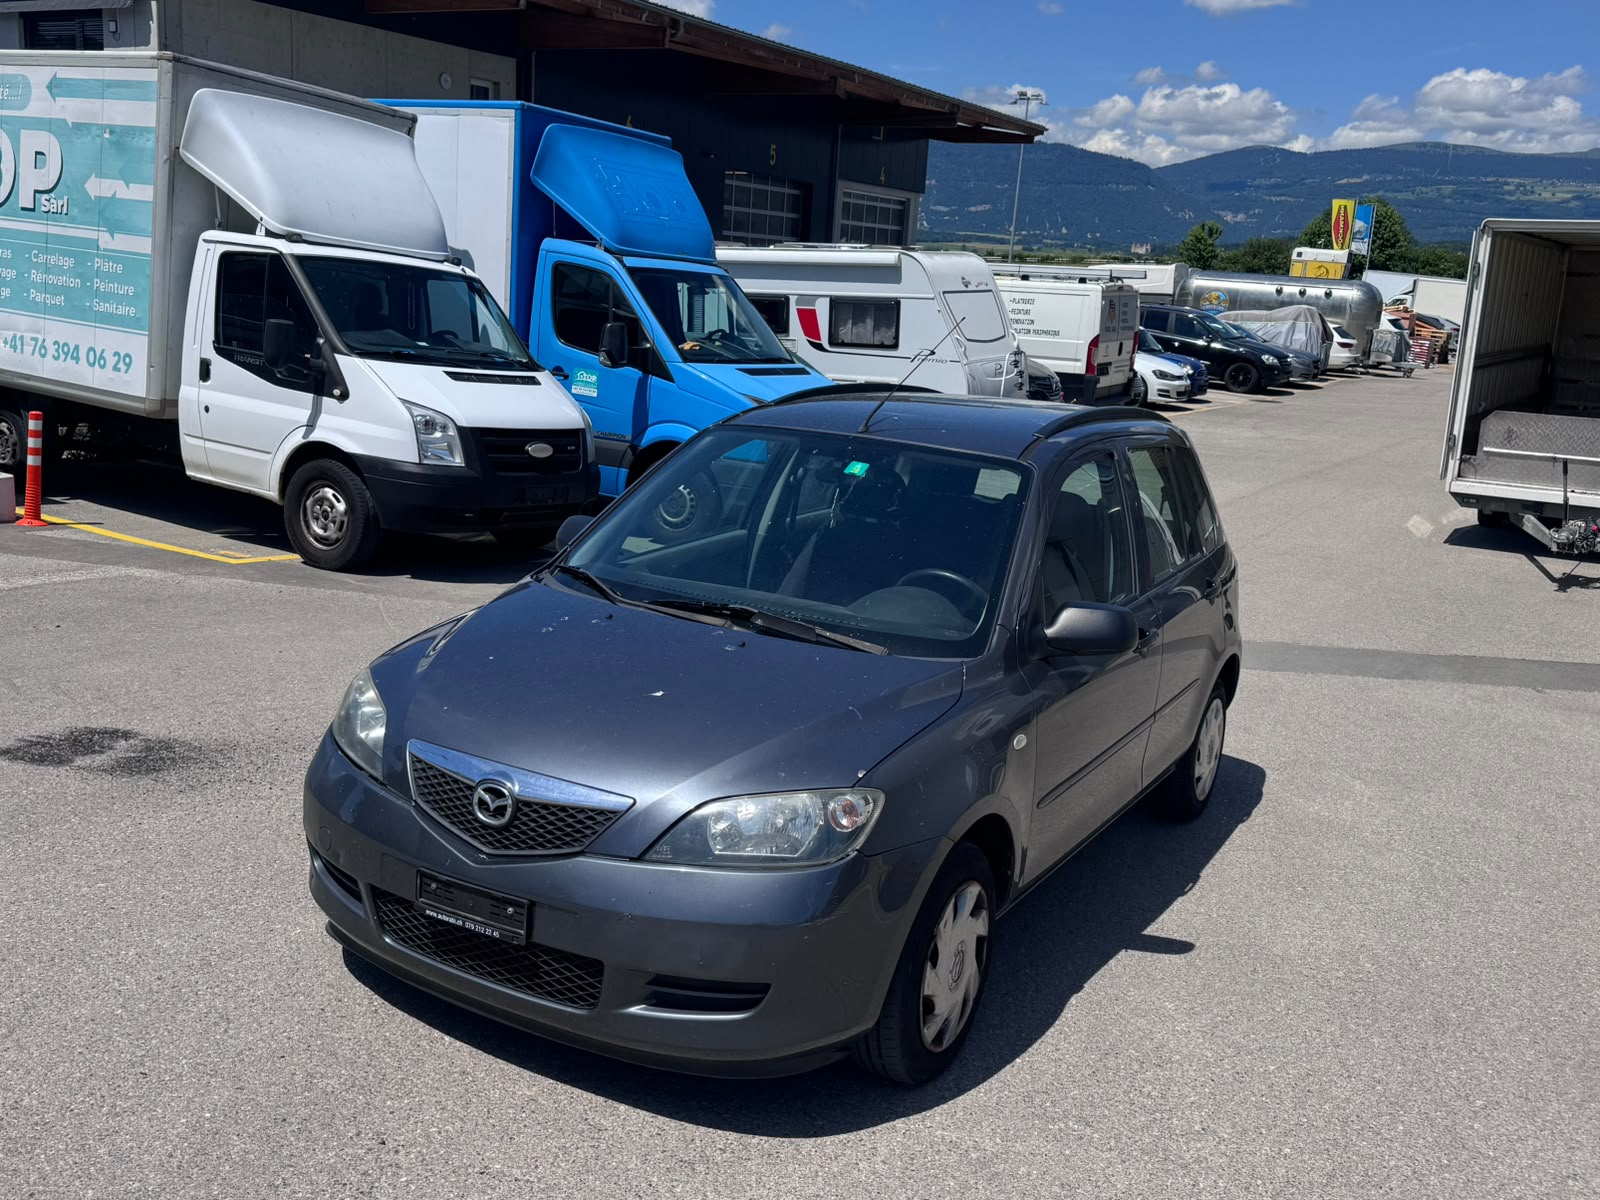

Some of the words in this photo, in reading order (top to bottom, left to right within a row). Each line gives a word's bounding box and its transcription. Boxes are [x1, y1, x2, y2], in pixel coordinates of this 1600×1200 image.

[769, 143, 777, 166] 5
[879, 165, 886, 185] 4
[31, 250, 75, 269] Carrelage
[30, 270, 81, 288] Rénovation
[93, 279, 135, 296] Peinture
[30, 289, 65, 306] Parquet
[92, 299, 136, 317] Sanitaire
[3, 333, 25, 355] +41
[30, 336, 48, 359] 76
[52, 340, 81, 365] 394
[86, 346, 107, 370] 06
[112, 351, 133, 374] 29
[464, 921, 475, 931] 079
[475, 924, 485, 934] 212
[485, 927, 492, 935] 22
[493, 930, 500, 938] 45
